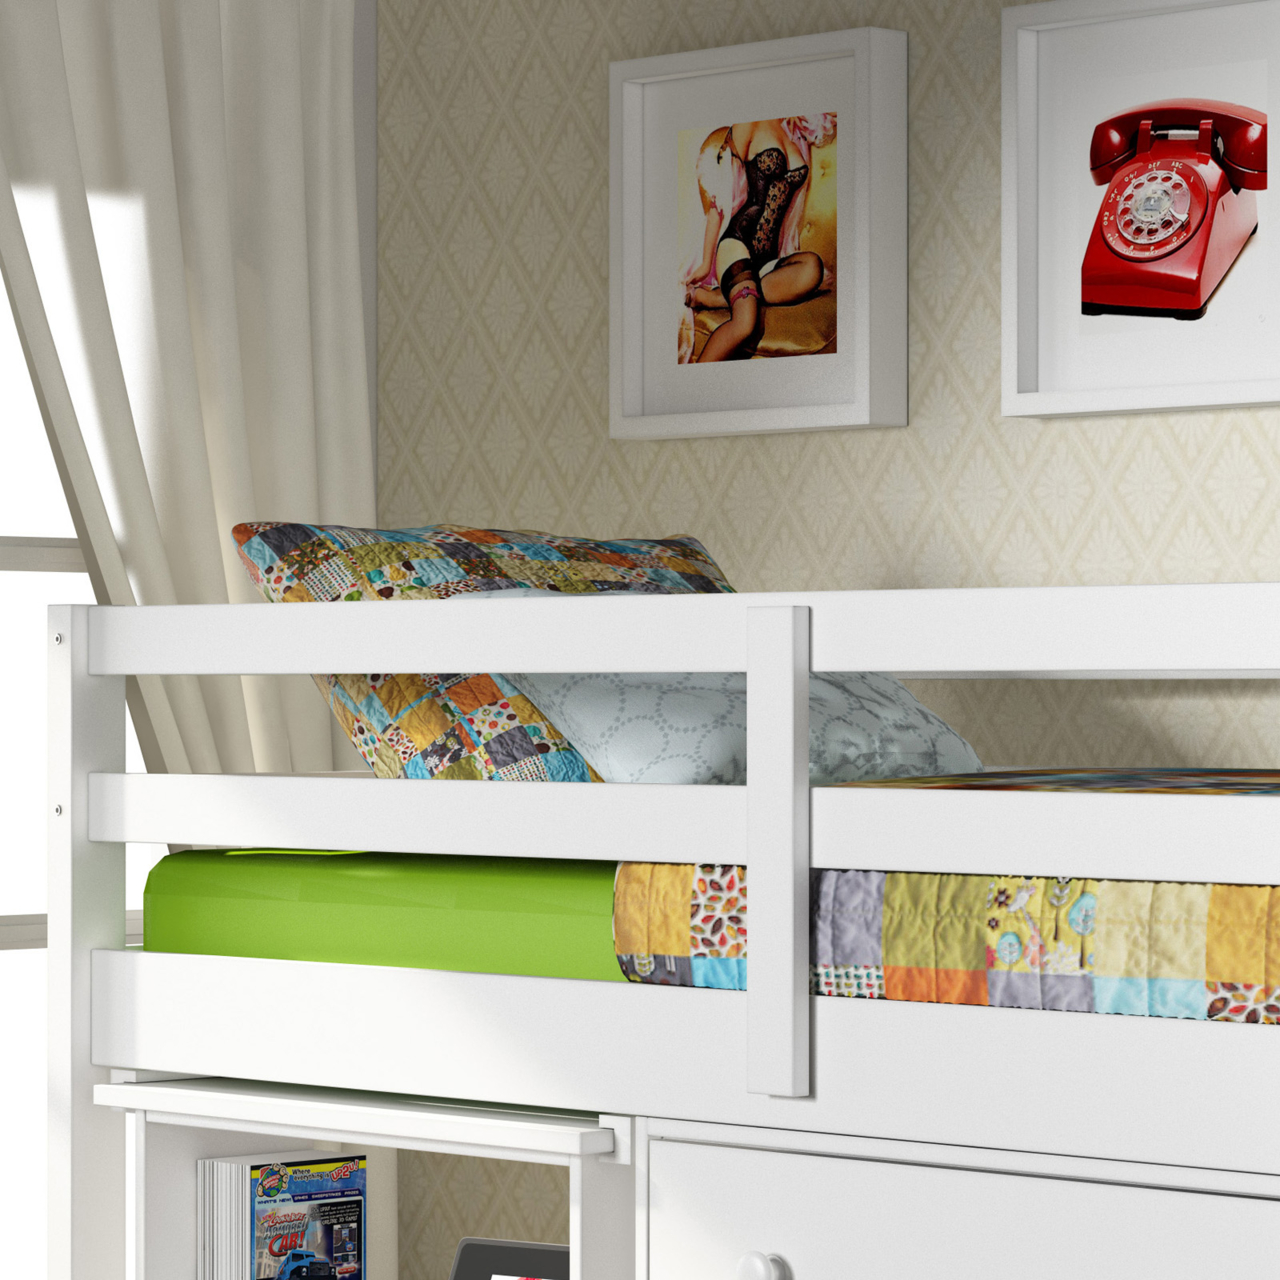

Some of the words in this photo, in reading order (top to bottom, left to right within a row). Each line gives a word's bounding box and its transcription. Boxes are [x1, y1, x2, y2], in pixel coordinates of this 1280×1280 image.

[1171, 161, 1183, 170] ABC
[292, 1168, 312, 1176] Where
[331, 1159, 360, 1182] UP2U!
[267, 1230, 306, 1257] CAR!
